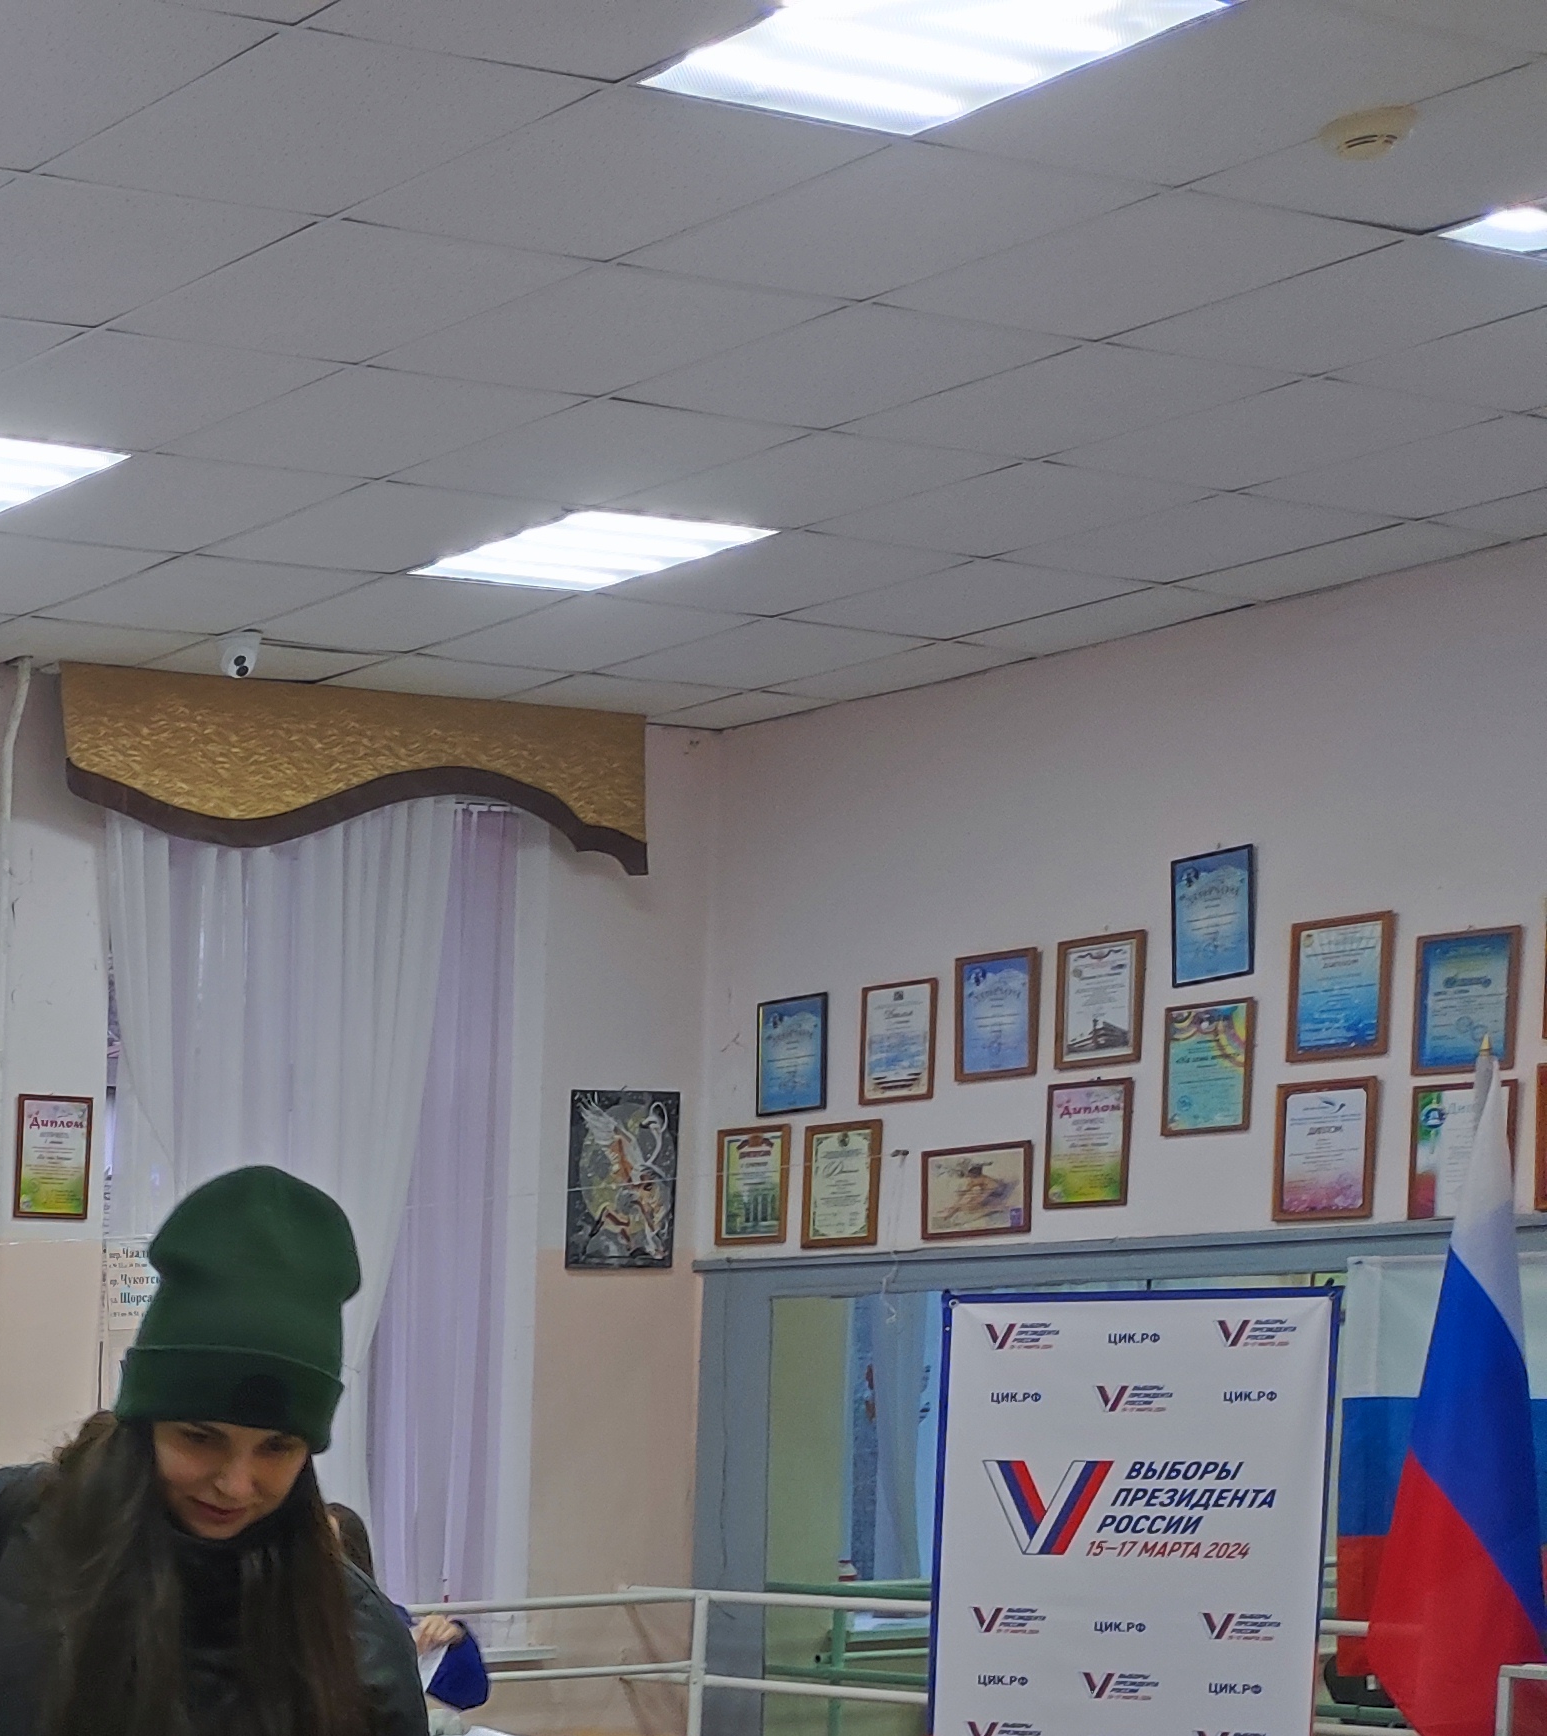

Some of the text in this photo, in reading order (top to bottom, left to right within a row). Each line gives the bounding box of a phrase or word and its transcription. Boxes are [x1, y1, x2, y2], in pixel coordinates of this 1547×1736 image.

[29, 1116, 84, 1130] Диплом
[1108, 1332, 1161, 1345] ЦИК.РФ
[990, 1392, 1042, 1405] ЦИК.РФ
[1222, 1390, 1278, 1404] ЦИК.РФ
[1124, 1460, 1245, 1481] ВЫБОРЫ
[1109, 1487, 1278, 1511] ПРЕЗИДЕНТА
[1096, 1514, 1204, 1535] РОССИИ
[1137, 1541, 1200, 1559] МАРТА
[1203, 1542, 1251, 1560] 2024
[1094, 1621, 1147, 1634] ЦИК.РФ
